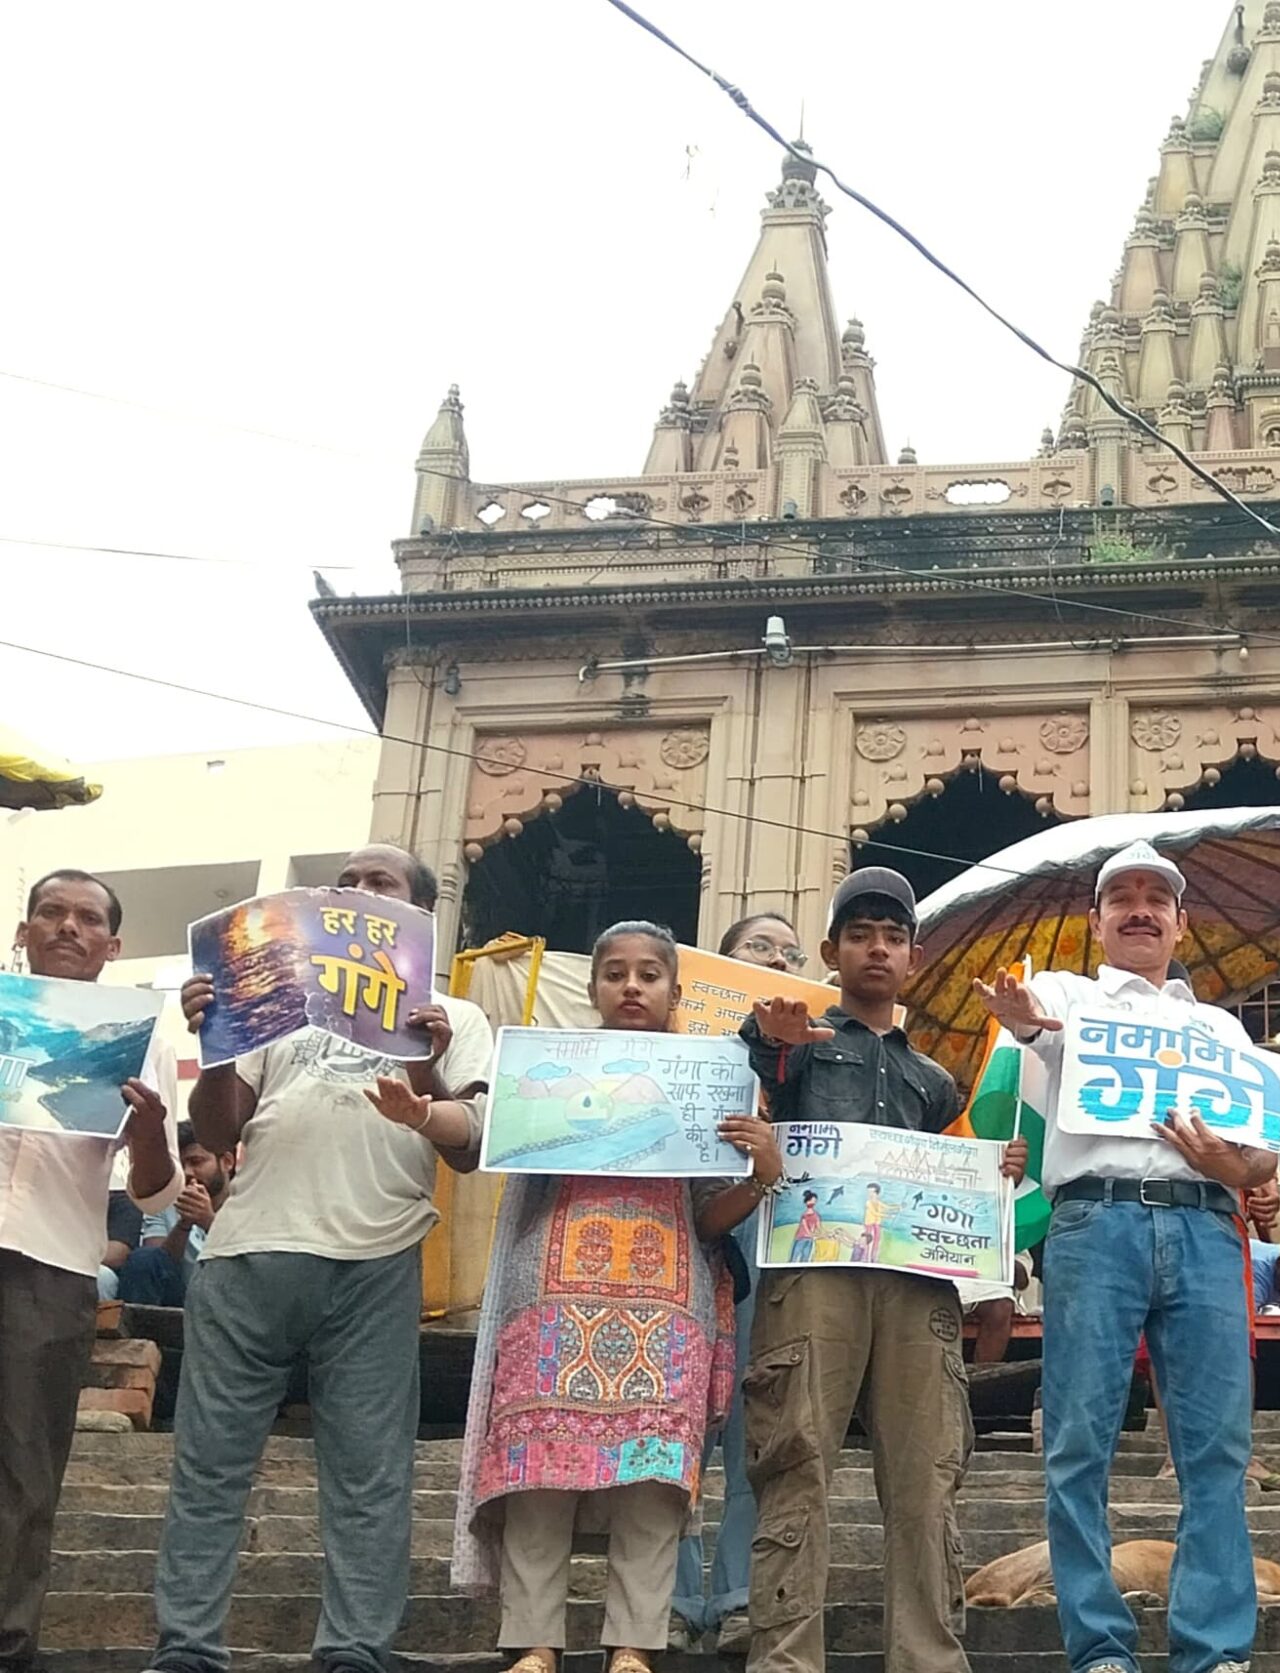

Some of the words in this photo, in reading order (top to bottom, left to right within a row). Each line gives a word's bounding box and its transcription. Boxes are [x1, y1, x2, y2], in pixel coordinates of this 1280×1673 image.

[320, 906, 357, 935] हर
[363, 914, 398, 946] हर
[310, 943, 406, 1032] गंगे
[1080, 1017, 1236, 1074] नमामि
[658, 1055, 709, 1080] गंगा
[711, 1056, 743, 1080] को
[919, 1194, 975, 1230] गंगा
[911, 1225, 992, 1249] स्वच्छता
[920, 1245, 977, 1266] अभियान
